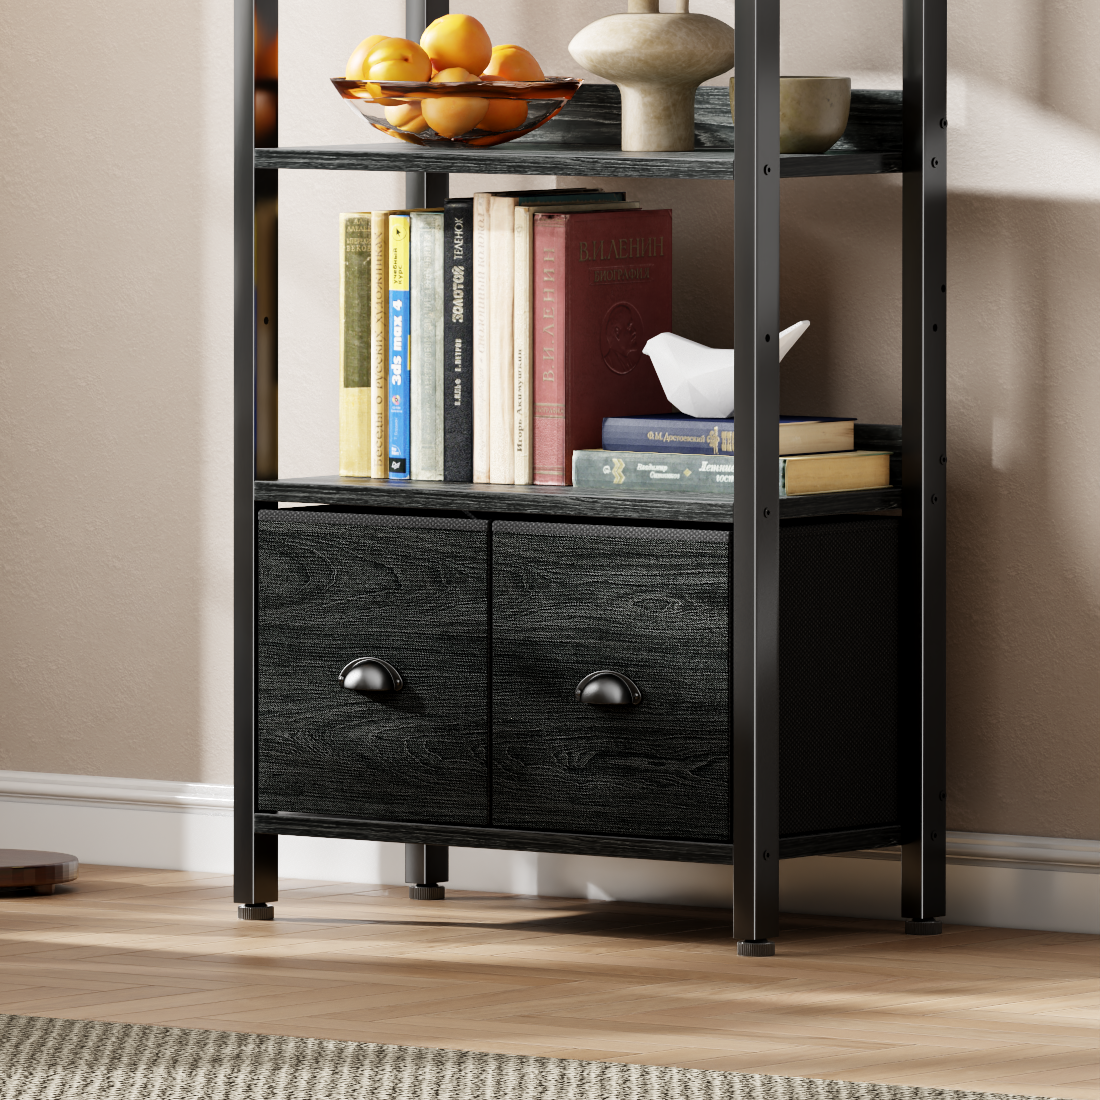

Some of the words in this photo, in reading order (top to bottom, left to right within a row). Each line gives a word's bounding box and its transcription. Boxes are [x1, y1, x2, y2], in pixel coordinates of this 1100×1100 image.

[453, 217, 464, 260] ТЕЛЕНОК
[374, 232, 387, 327] художниках
[451, 265, 465, 323] ЗОЛОТОЙ
[594, 267, 651, 283] БИОГРАФИЯ
[392, 299, 403, 311] 4
[392, 315, 403, 351] max
[374, 331, 387, 389] русских
[390, 355, 403, 386] 3ds
[375, 395, 384, 405] о
[516, 349, 524, 416] Акимушкин
[374, 412, 384, 467] Беседы
[516, 418, 525, 452] Игорь
